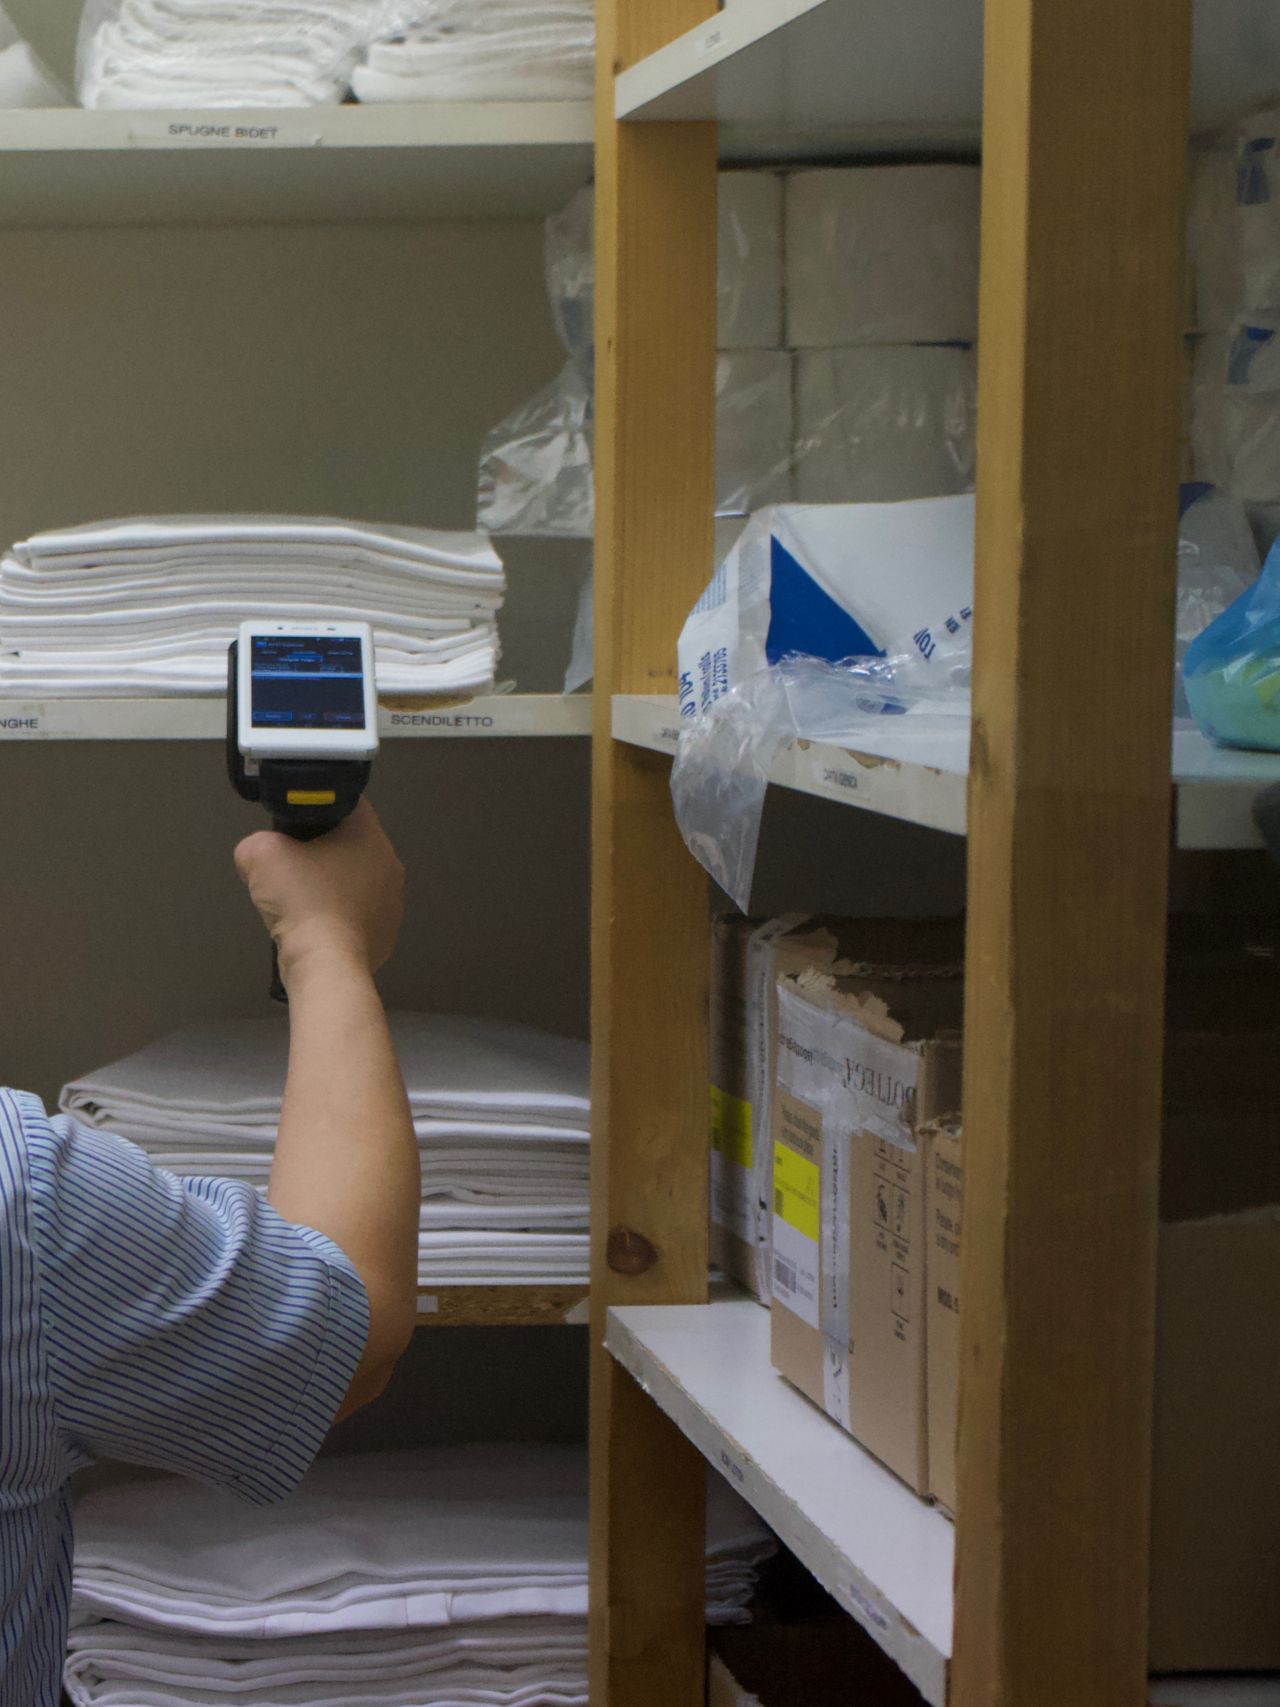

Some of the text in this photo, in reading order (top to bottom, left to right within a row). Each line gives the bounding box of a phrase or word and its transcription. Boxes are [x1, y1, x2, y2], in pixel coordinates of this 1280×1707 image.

[169, 124, 278, 139] SPUGNE BIDET
[391, 714, 494, 727] SCENDILETTO
